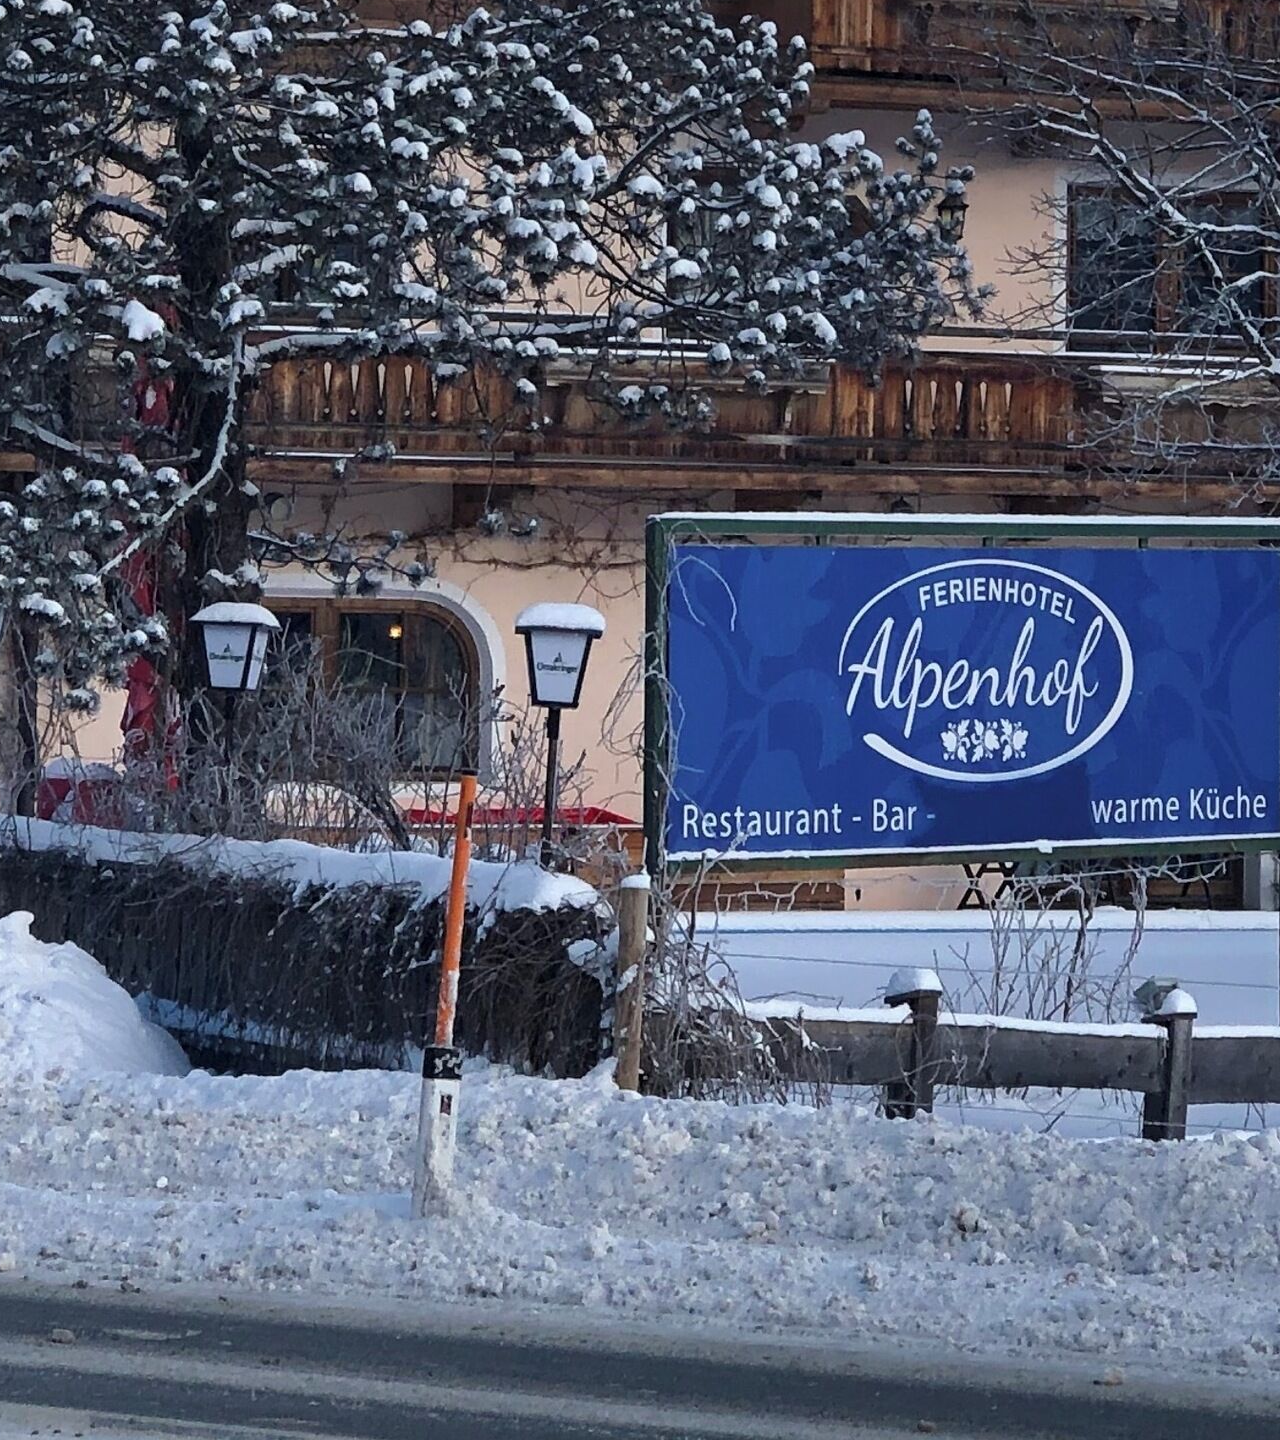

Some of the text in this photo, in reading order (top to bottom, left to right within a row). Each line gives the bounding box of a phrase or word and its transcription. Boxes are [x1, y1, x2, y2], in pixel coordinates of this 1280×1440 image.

[918, 577, 1076, 625] FERIENHOTEL
[847, 615, 1104, 739] Alpenhof
[682, 802, 842, 839] Restaurant
[872, 798, 918, 832] Bar
[1090, 785, 1267, 824] warme Küche
